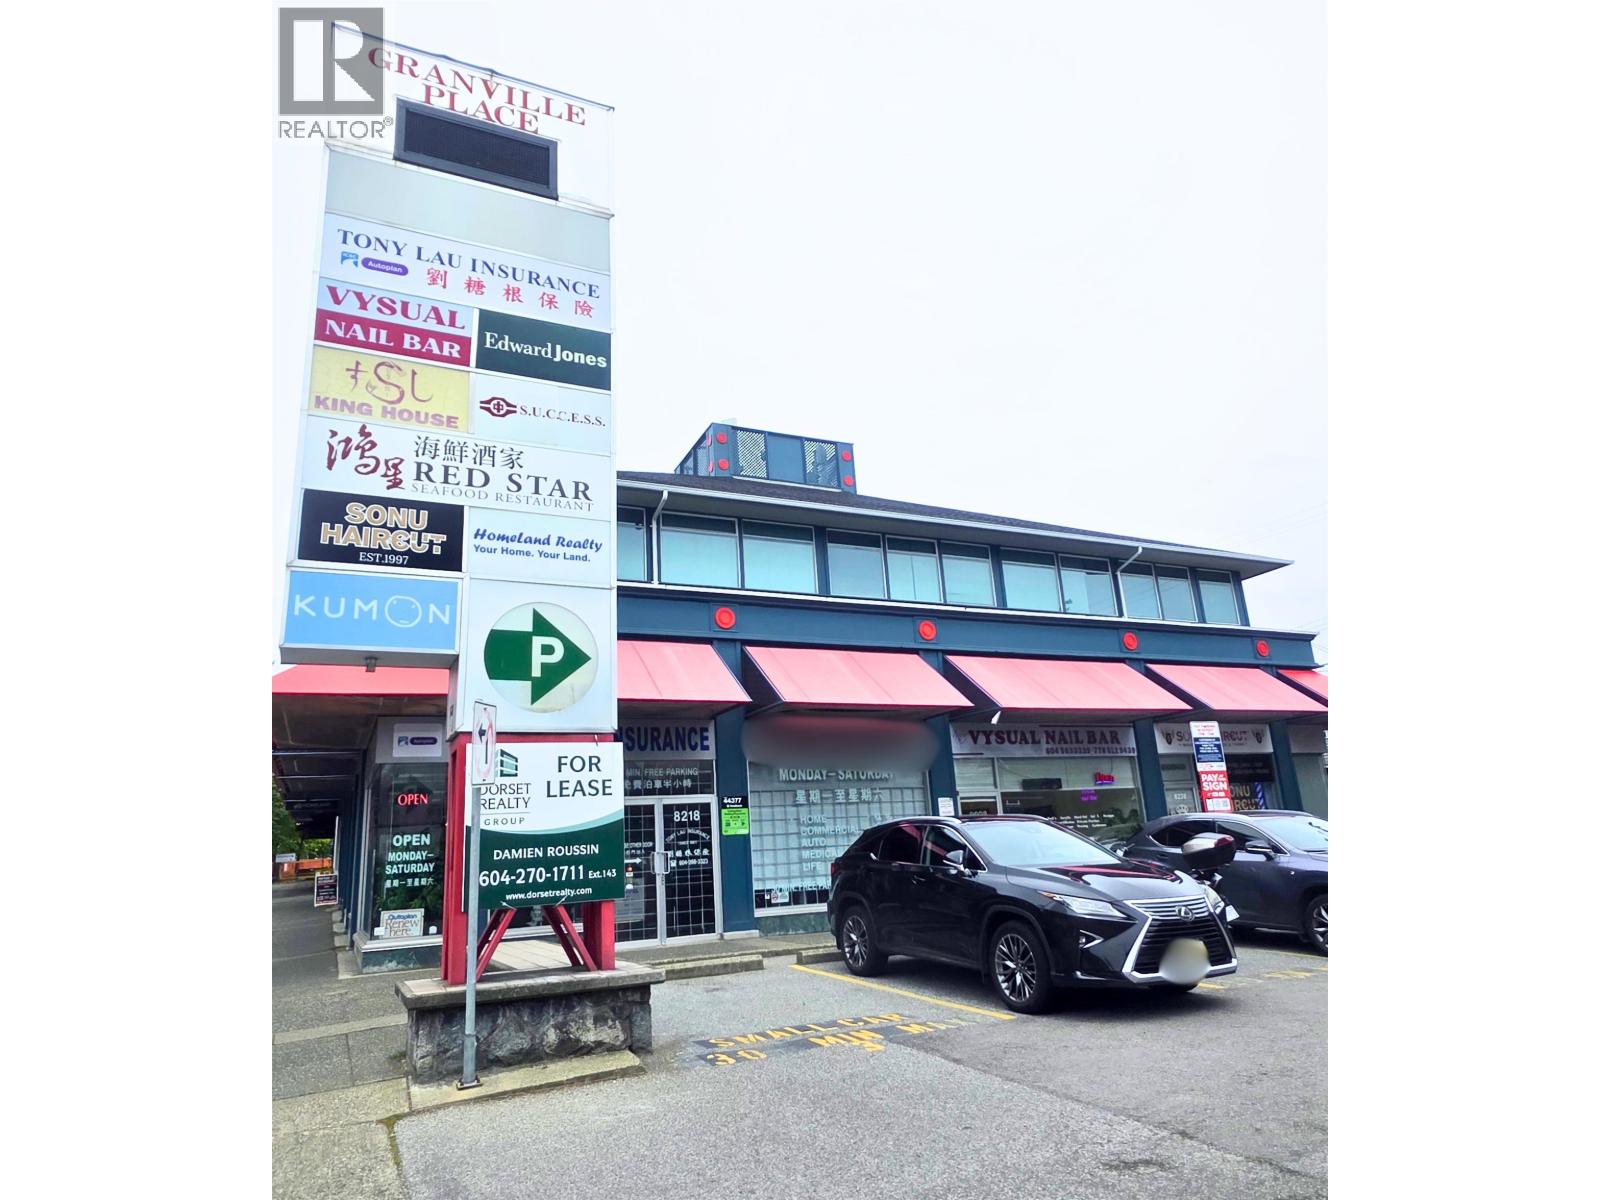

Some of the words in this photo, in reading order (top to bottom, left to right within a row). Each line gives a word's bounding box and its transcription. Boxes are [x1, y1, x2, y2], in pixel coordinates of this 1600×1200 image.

[367, 47, 586, 126] GRANVILLE
[422, 84, 540, 134] PLACE
[337, 229, 408, 257] TONY
[416, 245, 462, 268] LAU
[471, 258, 600, 299] INSURANCE
[367, 260, 403, 273] Autoplan
[326, 285, 466, 330] VYSUAL
[324, 319, 394, 347] NAIL
[402, 333, 462, 359] BAR
[484, 331, 552, 358] Edward
[553, 344, 607, 368] Jones
[314, 395, 373, 417] KING
[381, 404, 460, 429] HOUSE
[520, 404, 606, 427] S.U.C.C.E.S.S.
[414, 435, 524, 470] 海鮮酒家
[414, 461, 490, 488] RED
[506, 473, 593, 501] STAR
[411, 483, 488, 500] SEAFOOD
[496, 492, 594, 512] RESTAURANT
[345, 501, 428, 530] SONU
[320, 522, 447, 555] HAIRCUT
[556, 536, 603, 552] Realty
[359, 551, 409, 565] EST.1997
[473, 544, 497, 554] Your
[501, 546, 534, 557] Home.
[537, 549, 560, 560] Your
[563, 552, 591, 562] Land.
[293, 594, 450, 628] KUMON
[531, 636, 564, 677] P
[617, 726, 710, 752] SURANCE
[968, 730, 1041, 745] VYSUAL
[1044, 730, 1085, 745] NAIL
[1086, 730, 1121, 745] BAR
[558, 755, 602, 773] FOR
[644, 768, 664, 777] FREE
[666, 767, 699, 776] PARKING
[1201, 773, 1218, 782] PAY
[1202, 781, 1228, 791] SIGN
[546, 779, 612, 798] LEASE
[1229, 785, 1250, 797] ONU
[397, 793, 429, 806] OPEN
[480, 797, 531, 810] REALTY
[484, 817, 525, 826] GROUP
[673, 810, 700, 822] 8218
[800, 815, 827, 824] HOME
[800, 825, 861, 835] COMMERCIAL
[392, 834, 431, 847] OPEN
[801, 838, 827, 847] AUTO
[493, 847, 543, 860] DAMIEN
[547, 844, 600, 857] ROUSSIN
[385, 862, 435, 875] SATURDAY
[802, 861, 823, 871] LIFE
[479, 864, 584, 887] 604-270-1711
[506, 887, 592, 900] www.dorsetrealty.com
[708, 1023, 838, 1048] SMALL
[837, 1012, 908, 1027] CAR
[707, 1050, 768, 1067] 30
